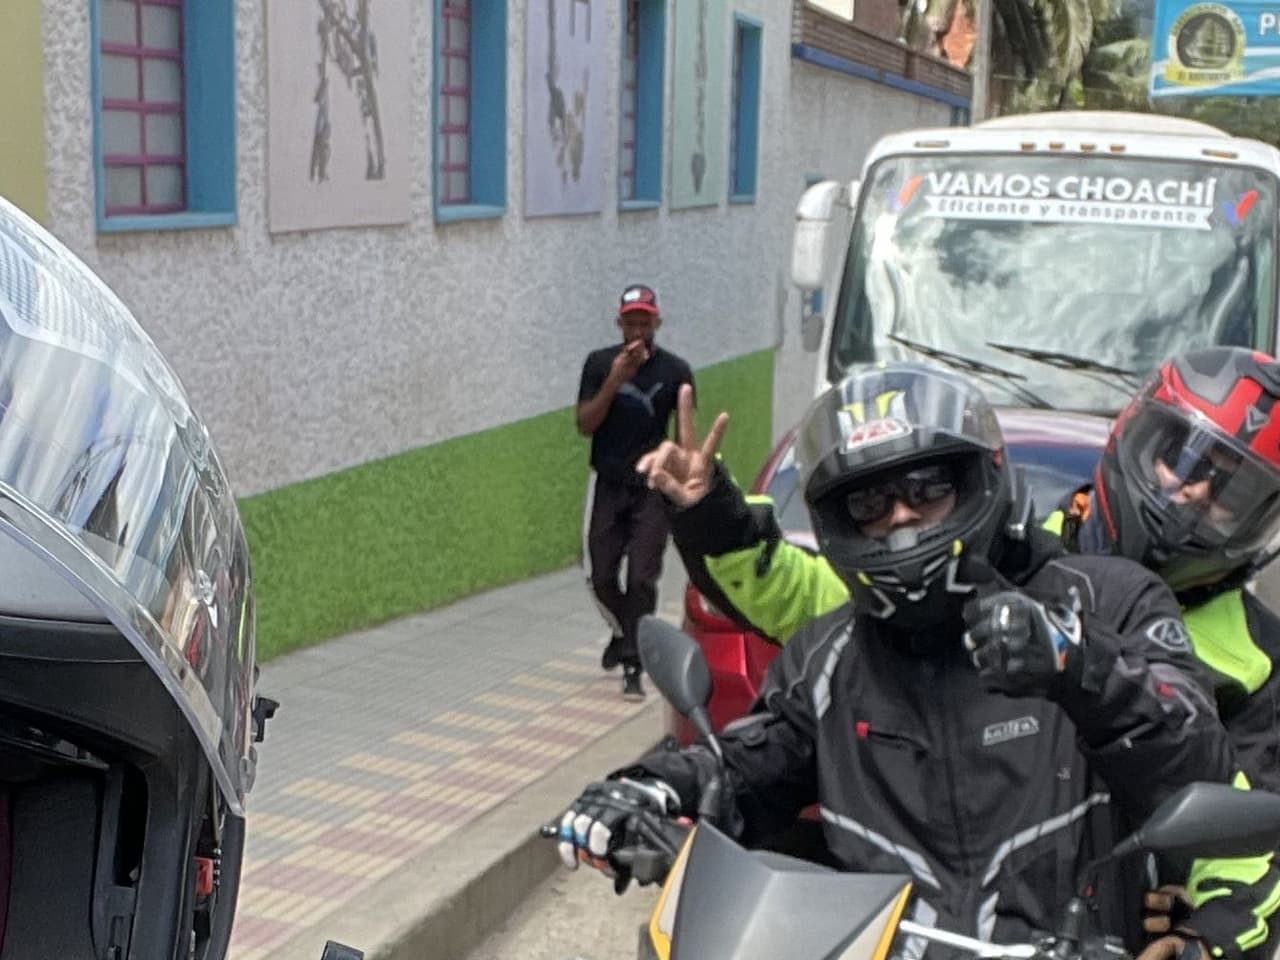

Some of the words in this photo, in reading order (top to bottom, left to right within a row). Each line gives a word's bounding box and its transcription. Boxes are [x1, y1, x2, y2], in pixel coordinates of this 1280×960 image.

[927, 172, 1051, 198] VAMOS
[1056, 176, 1217, 206] CHOACHÍ
[939, 199, 1031, 215] Eficiente
[1040, 204, 1051, 217] y
[1059, 204, 1198, 223] transparente
